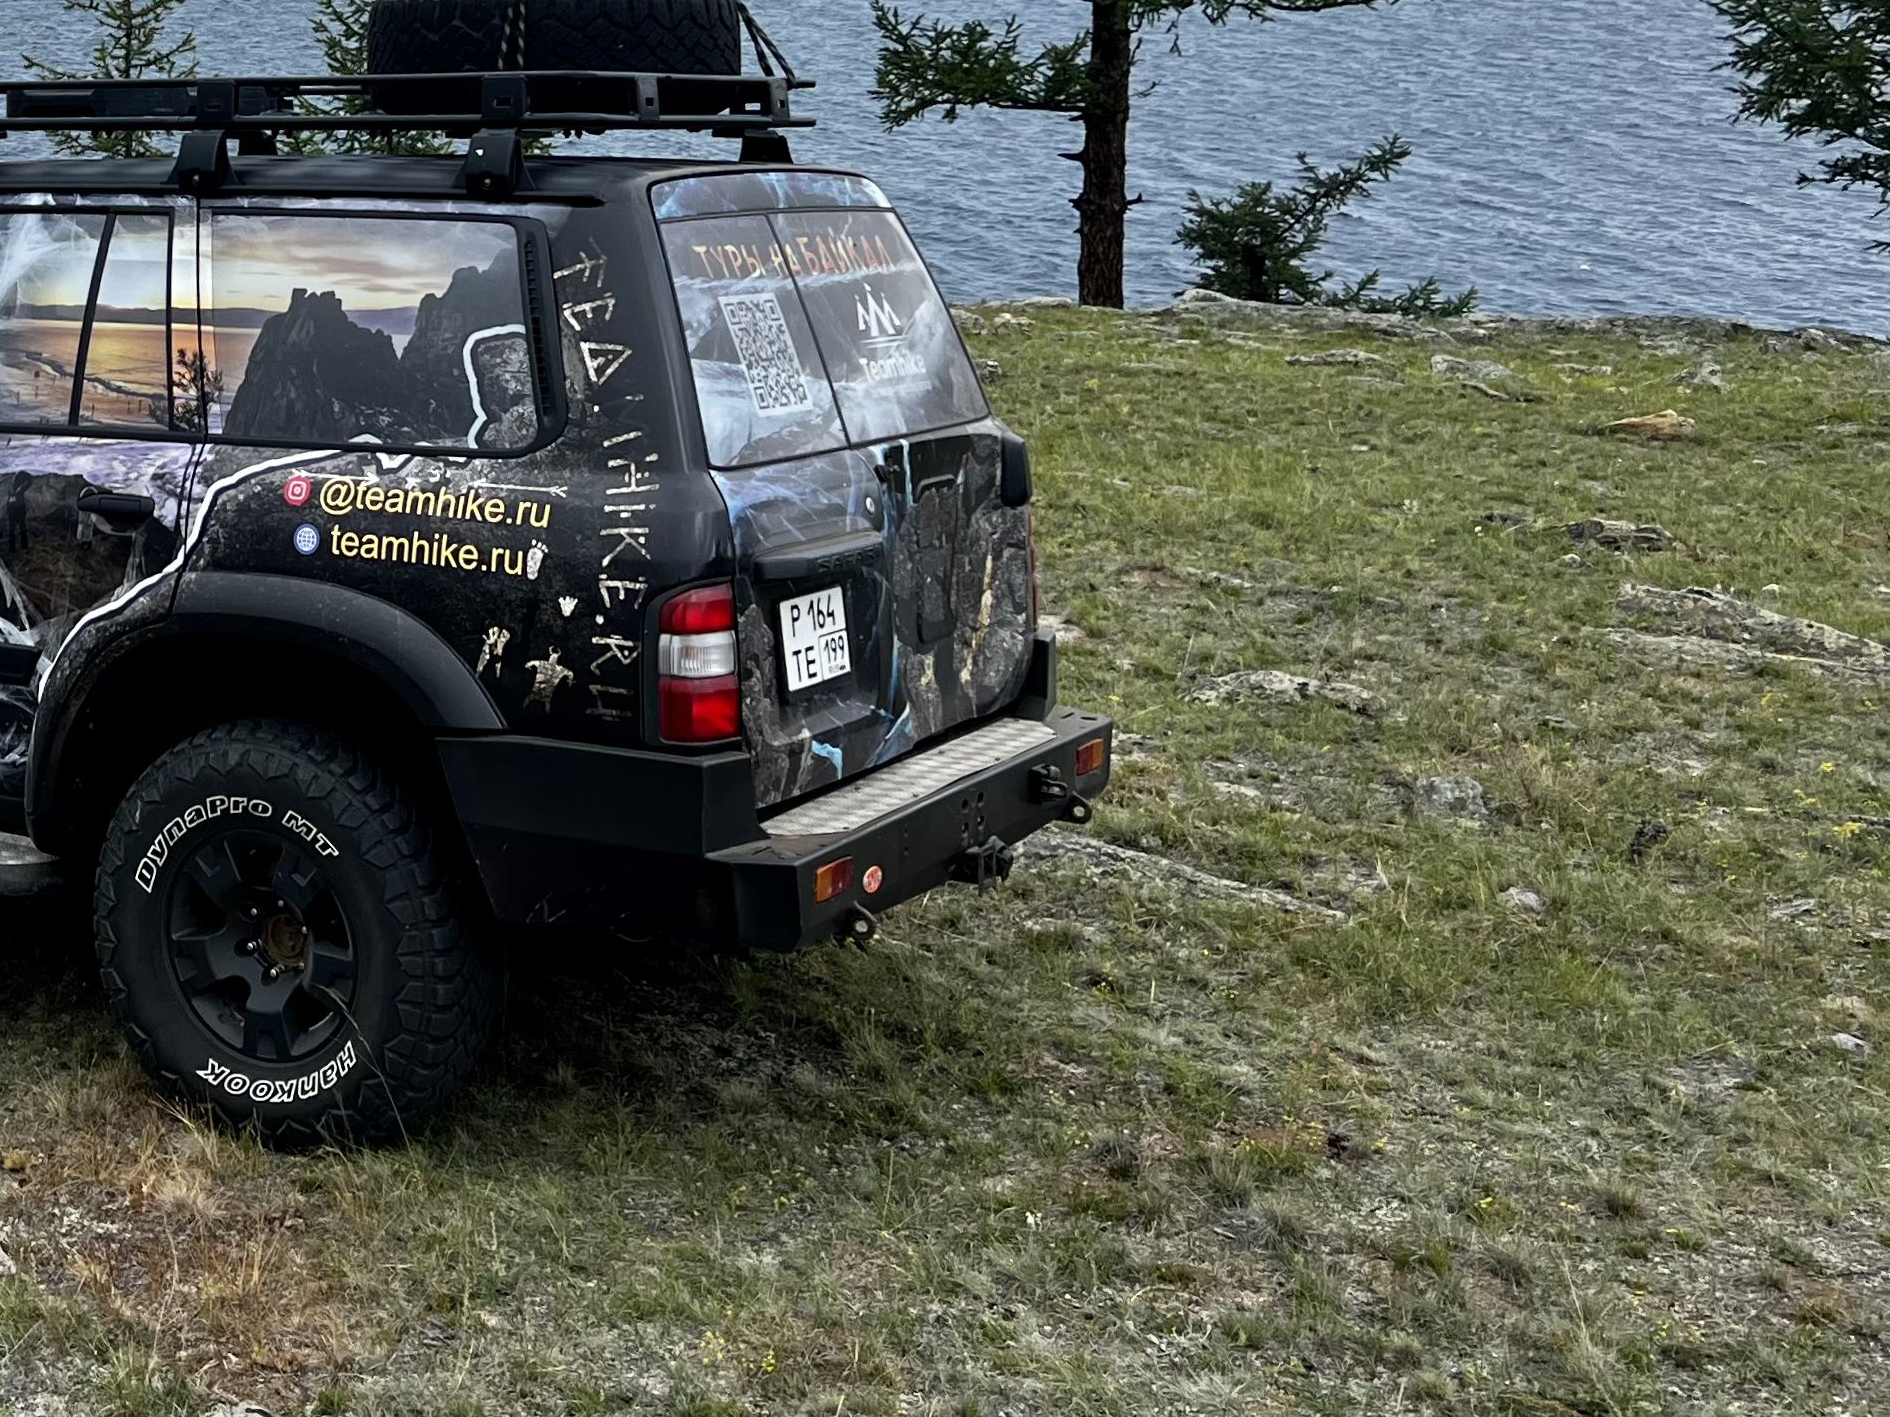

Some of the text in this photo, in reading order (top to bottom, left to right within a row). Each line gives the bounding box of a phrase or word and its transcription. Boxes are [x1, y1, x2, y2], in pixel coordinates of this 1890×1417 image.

[692, 227, 895, 279] ТУРЫ НА БАЙКАЛ
[319, 475, 551, 529] @teamhike.ru
[330, 524, 524, 575] teamhike.ru
[807, 594, 836, 632] 164
[823, 635, 845, 664] 199
[282, 810, 339, 858] MT
